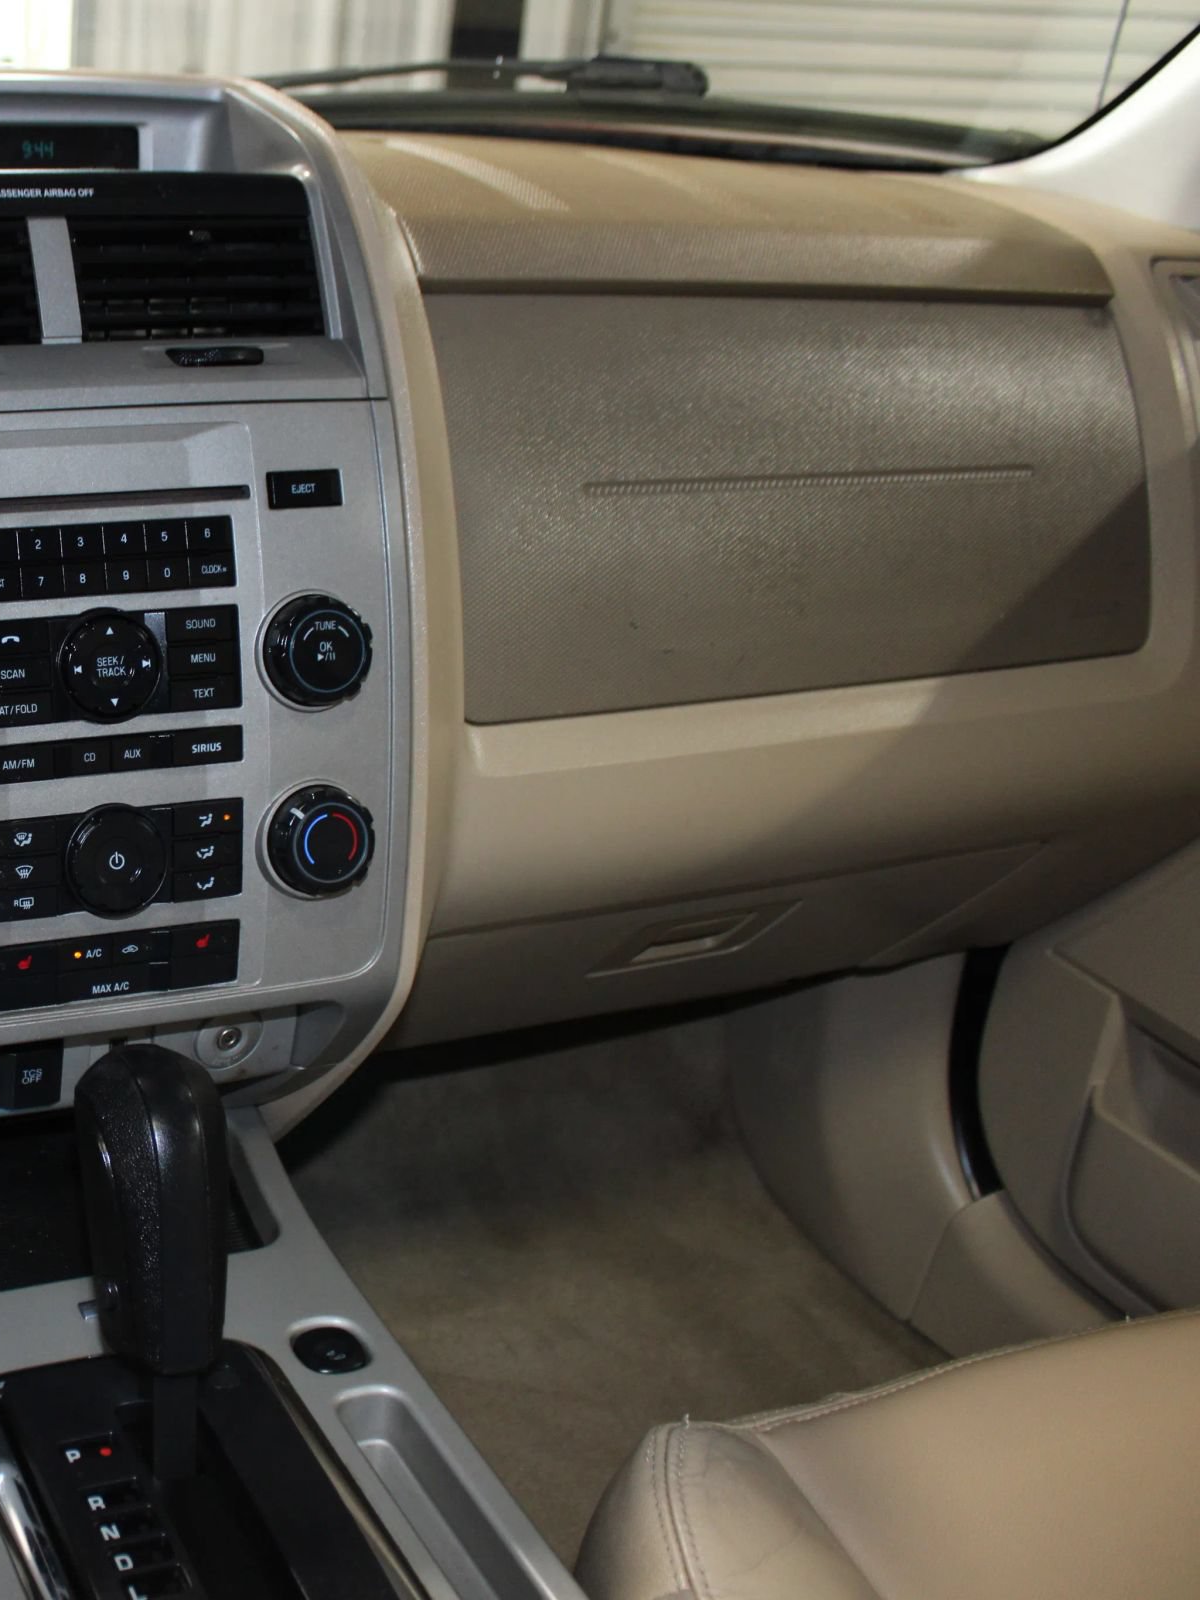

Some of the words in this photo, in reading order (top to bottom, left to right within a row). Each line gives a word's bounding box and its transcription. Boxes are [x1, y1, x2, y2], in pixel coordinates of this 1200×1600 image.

[43, 188, 76, 197] AIRBAG
[78, 188, 94, 197] OFF
[291, 483, 316, 494] EJECT
[120, 533, 128, 543] 4
[161, 531, 168, 542] 5
[204, 527, 211, 538] 6
[34, 539, 42, 550] 2
[77, 536, 84, 547] 3
[122, 570, 130, 581] 9
[163, 567, 171, 578] 0
[201, 564, 222, 575] CLOCK
[38, 576, 44, 586] 7
[79, 573, 86, 584] 8
[185, 616, 216, 629] SOUND
[314, 621, 336, 631] TUNE
[319, 640, 333, 652] OK
[190, 652, 216, 664] MENU
[0, 668, 26, 681] SCAN
[97, 666, 126, 678] TRACK
[193, 687, 215, 699] TEXT
[123, 747, 141, 759] AUX
[191, 741, 222, 754] SIRIUS
[83, 751, 96, 763] CD
[2, 757, 36, 771] AM/FM
[85, 948, 102, 960] A/C
[92, 982, 112, 994] MAX
[114, 980, 129, 992] A/C
[22, 1068, 42, 1078] TCS
[21, 1076, 42, 1085] OFF
[65, 1449, 81, 1464] P
[88, 1496, 105, 1511] R
[101, 1525, 120, 1541] N
[114, 1554, 133, 1572] D
[129, 1584, 147, 1600] L
